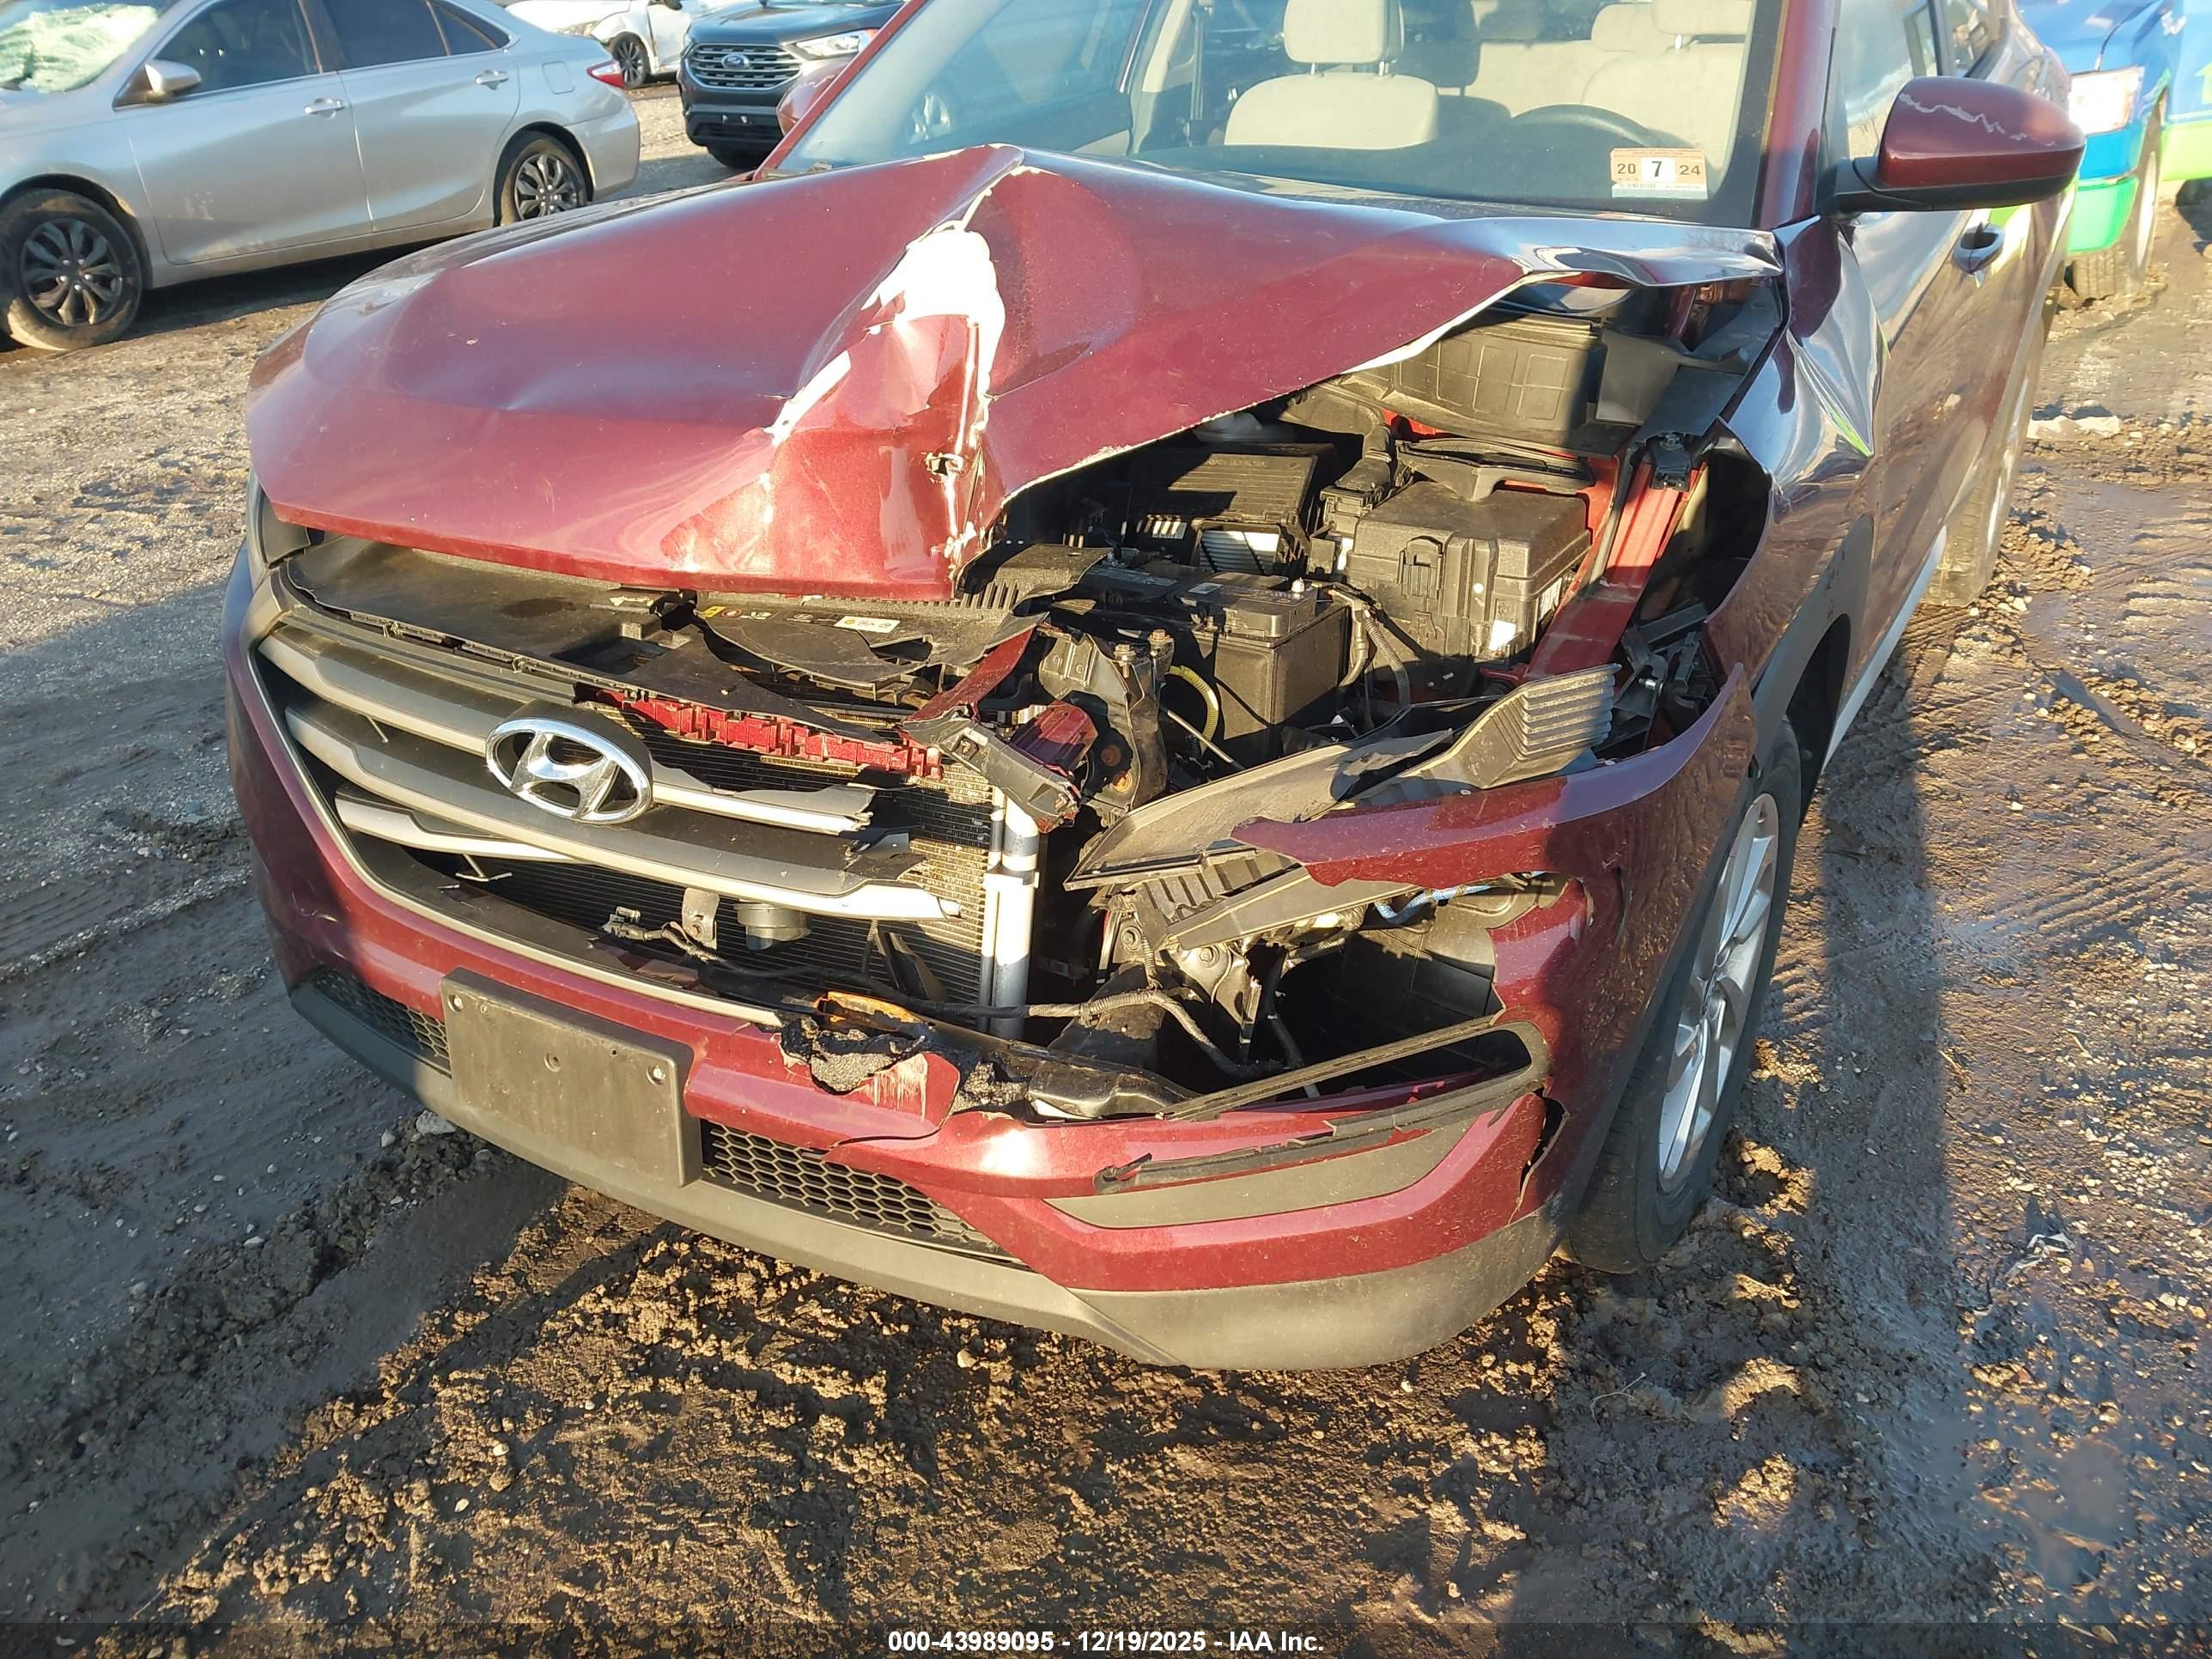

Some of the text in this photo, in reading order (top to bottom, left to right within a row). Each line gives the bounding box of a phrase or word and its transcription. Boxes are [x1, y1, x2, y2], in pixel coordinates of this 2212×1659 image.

[1617, 161, 1701, 177] 20 7 24
